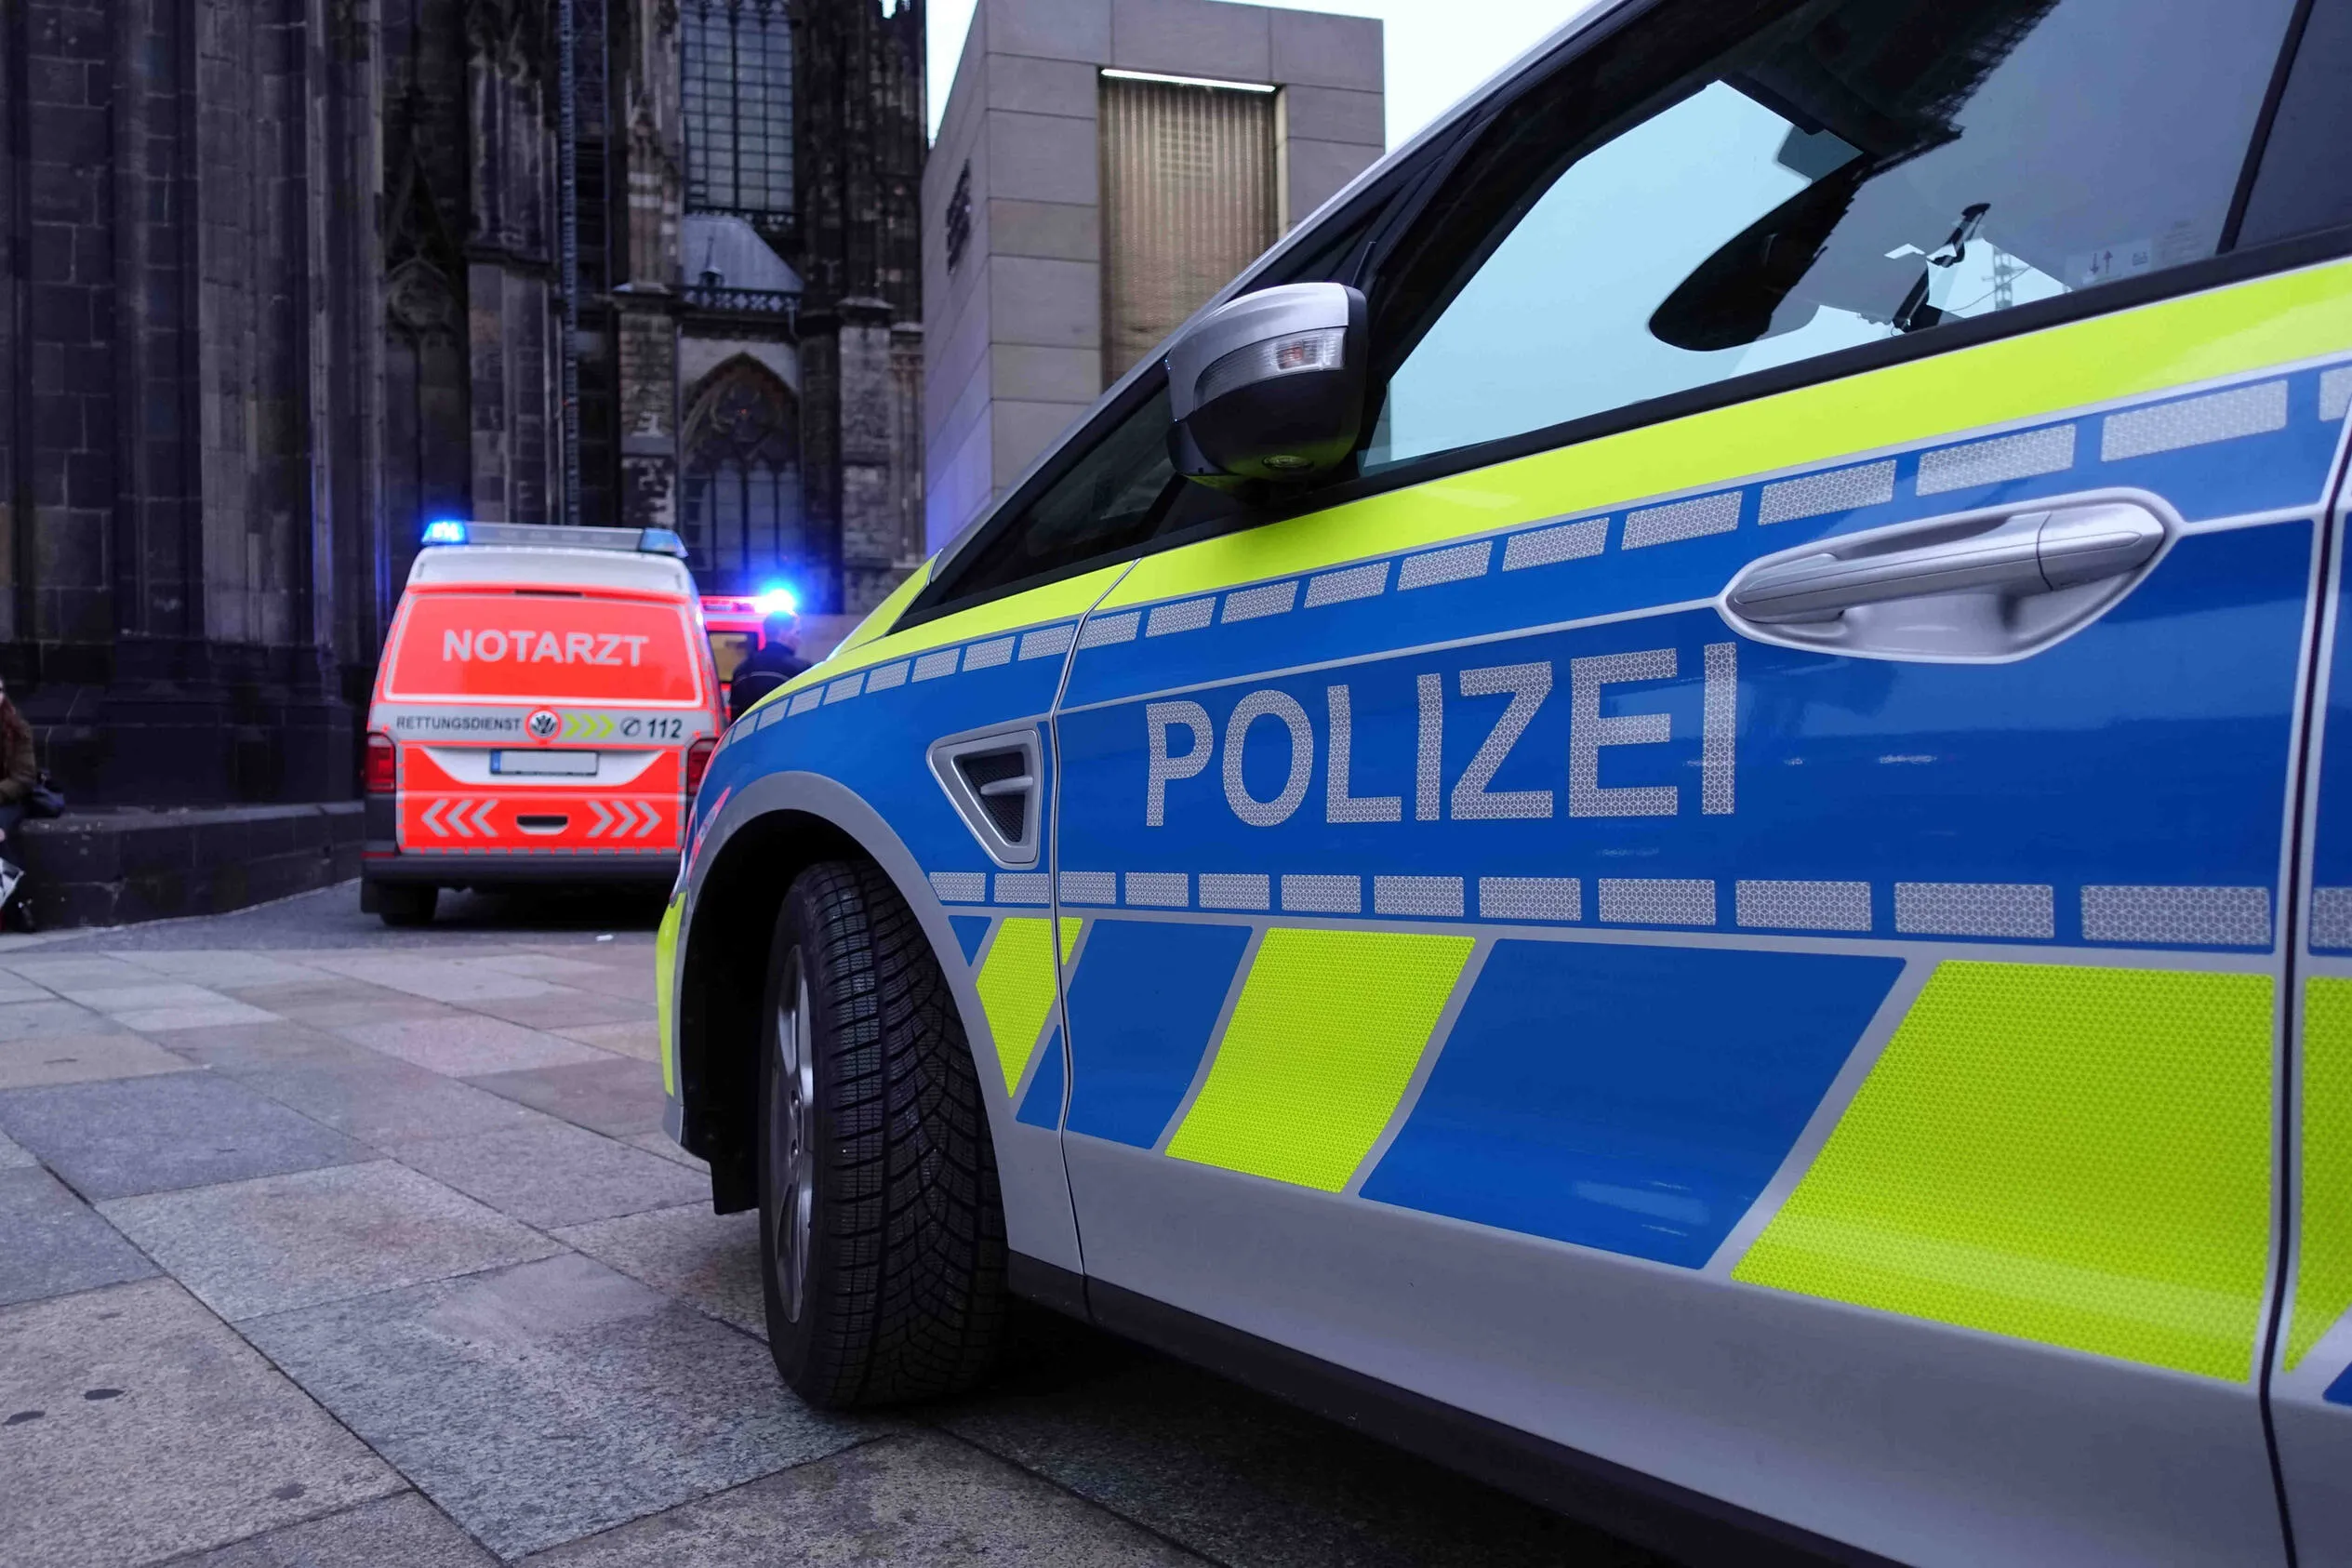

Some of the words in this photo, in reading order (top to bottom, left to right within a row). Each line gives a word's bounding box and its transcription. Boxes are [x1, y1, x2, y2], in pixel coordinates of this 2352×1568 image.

[443, 629, 650, 667] NOTARZT
[396, 715, 522, 732] RETTUNGSDIENST
[647, 717, 683, 738] 112
[1146, 642, 1736, 827] POLIZEI
